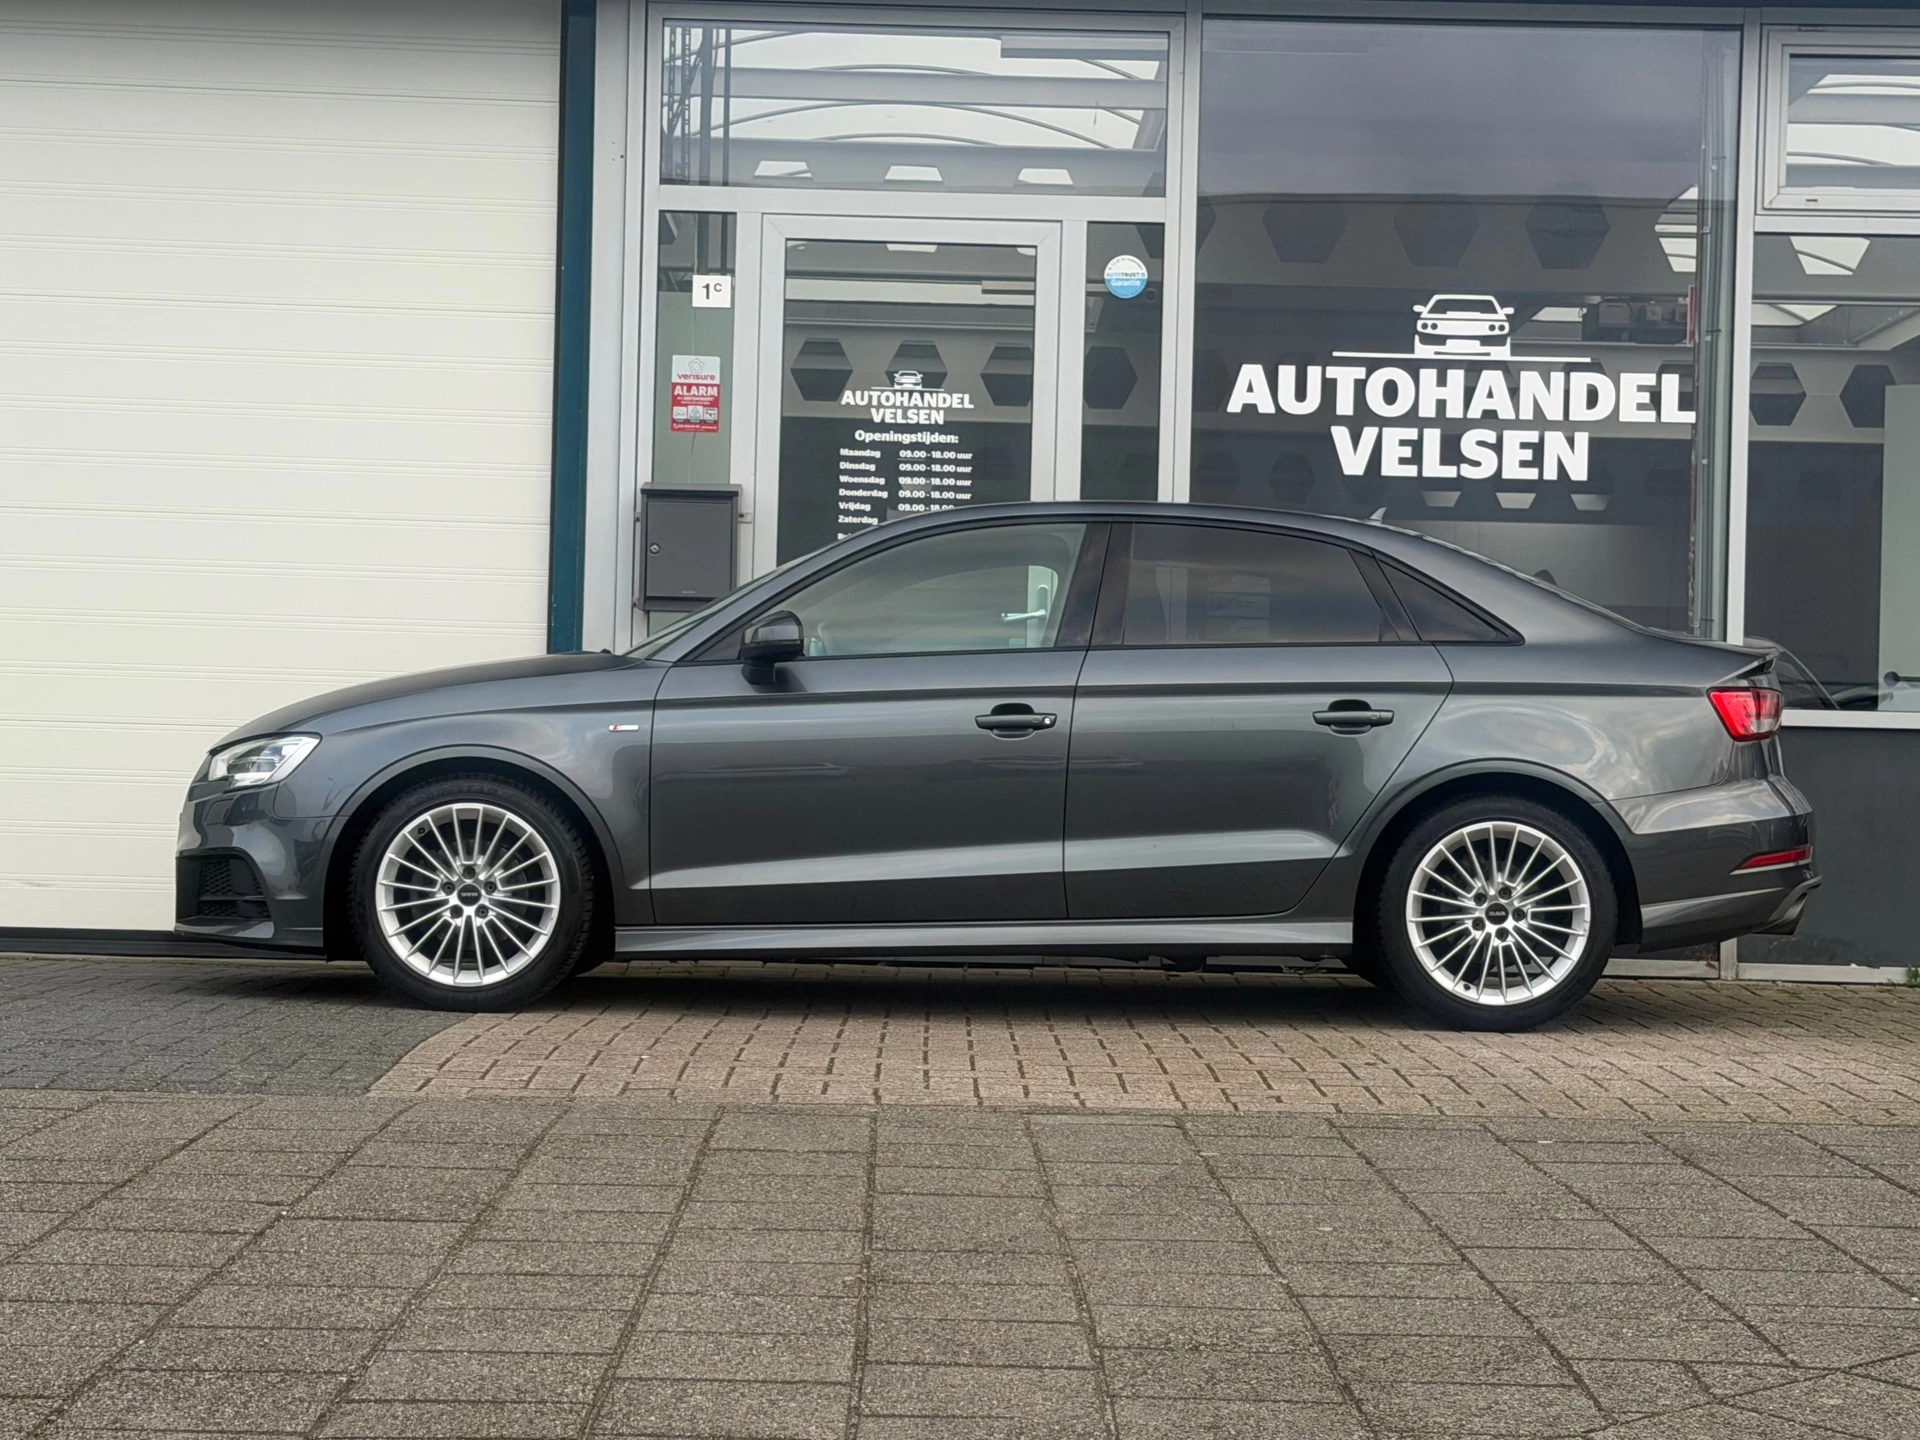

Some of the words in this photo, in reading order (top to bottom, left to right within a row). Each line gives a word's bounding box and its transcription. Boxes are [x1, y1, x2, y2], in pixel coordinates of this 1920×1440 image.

[677, 373, 716, 381] verisure
[673, 385, 718, 397] ALARM
[1227, 364, 1696, 424] AUTOHANDEL
[841, 390, 974, 409] AUTOHANDEL
[871, 408, 944, 425] VELSEN
[855, 430, 959, 445] Openingstijden:
[840, 448, 881, 459] Maandag
[957, 452, 973, 460] uur
[1331, 426, 1589, 481] VELSEN
[840, 461, 876, 472] Dinsdag
[839, 475, 885, 486] Woensdag
[839, 488, 888, 499] Donderdag
[839, 502, 871, 512] Vrijdag
[838, 514, 879, 526] Zaterdag
